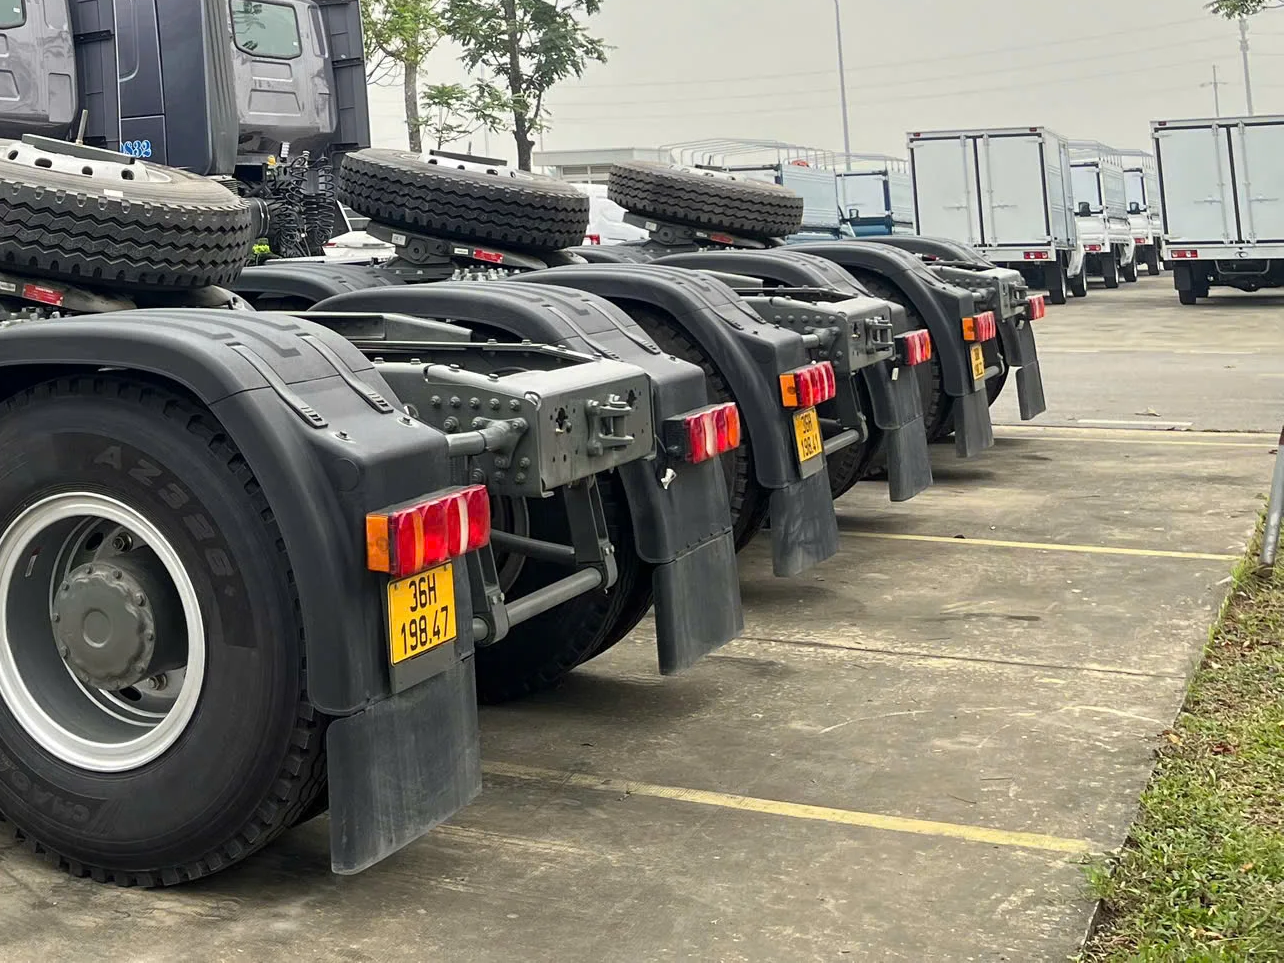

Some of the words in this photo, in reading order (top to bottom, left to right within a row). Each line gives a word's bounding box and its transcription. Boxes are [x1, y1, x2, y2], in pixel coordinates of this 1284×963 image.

[120, 139, 152, 158] 832
[408, 572, 438, 613] 36H
[400, 604, 450, 655] 198.47
